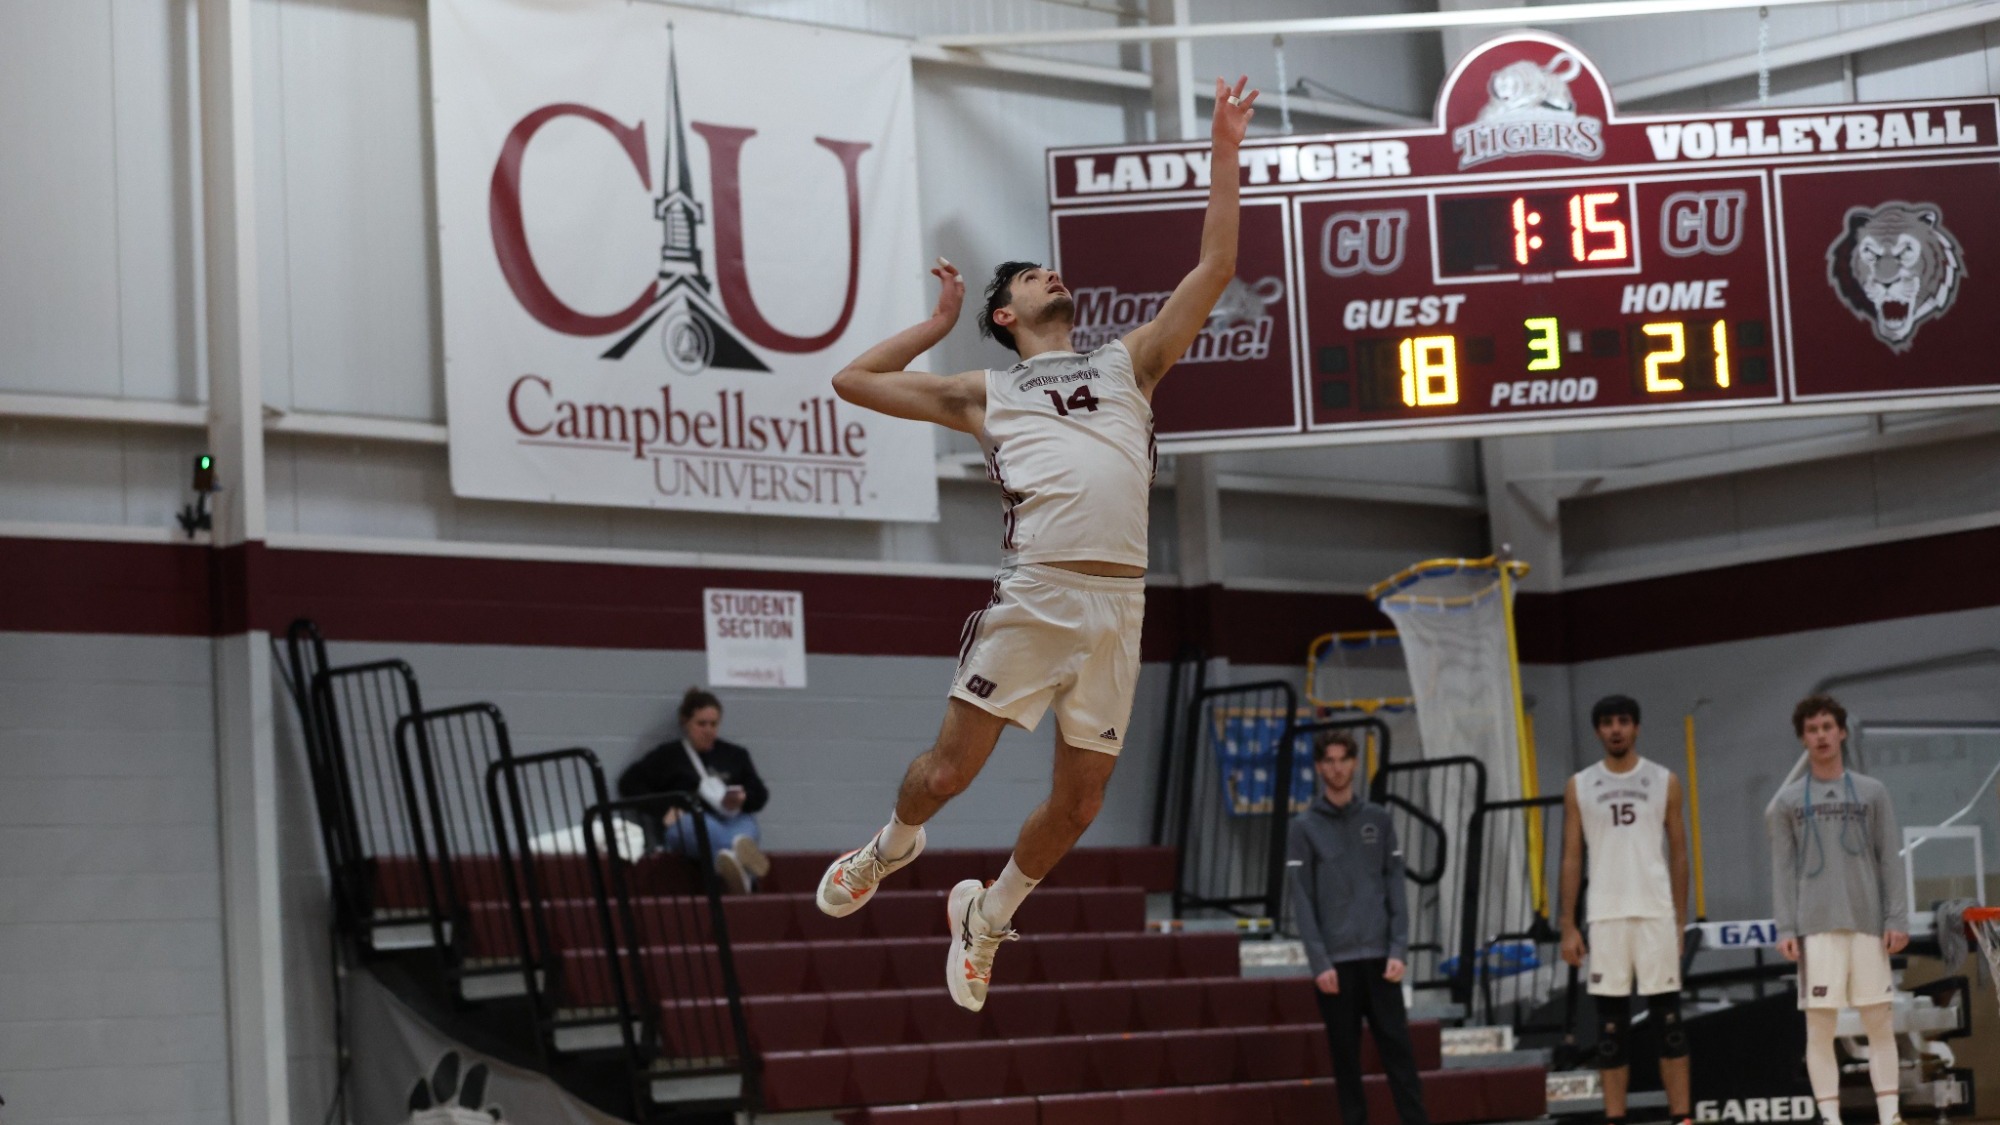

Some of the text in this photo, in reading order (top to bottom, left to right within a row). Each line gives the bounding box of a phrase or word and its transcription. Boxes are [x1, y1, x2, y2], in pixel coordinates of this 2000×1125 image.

[1453, 115, 1604, 170] TIGERS
[1647, 110, 1977, 161] VOLLEYBALL
[1075, 140, 1411, 195] LADY TIGER
[489, 102, 872, 354] CU
[1321, 209, 1409, 277] CU
[1512, 192, 1628, 265] 1:15
[1661, 190, 1747, 257] CU
[1343, 294, 1466, 331] GUEST
[1620, 279, 1729, 314] HOME
[1524, 317, 1561, 371] 3
[1642, 319, 1730, 392] 21
[1400, 335, 1459, 407] 18
[1491, 376, 1598, 407] PERIOD
[508, 374, 867, 460] Campbellsville
[1043, 385, 1099, 416] 14
[652, 457, 868, 506] UNIVERSITY
[711, 593, 796, 617] STUDENT
[718, 618, 794, 639] SECTION
[966, 674, 997, 699] CU
[1610, 803, 1636, 827] 15
[1695, 1096, 1815, 1123] GARED
